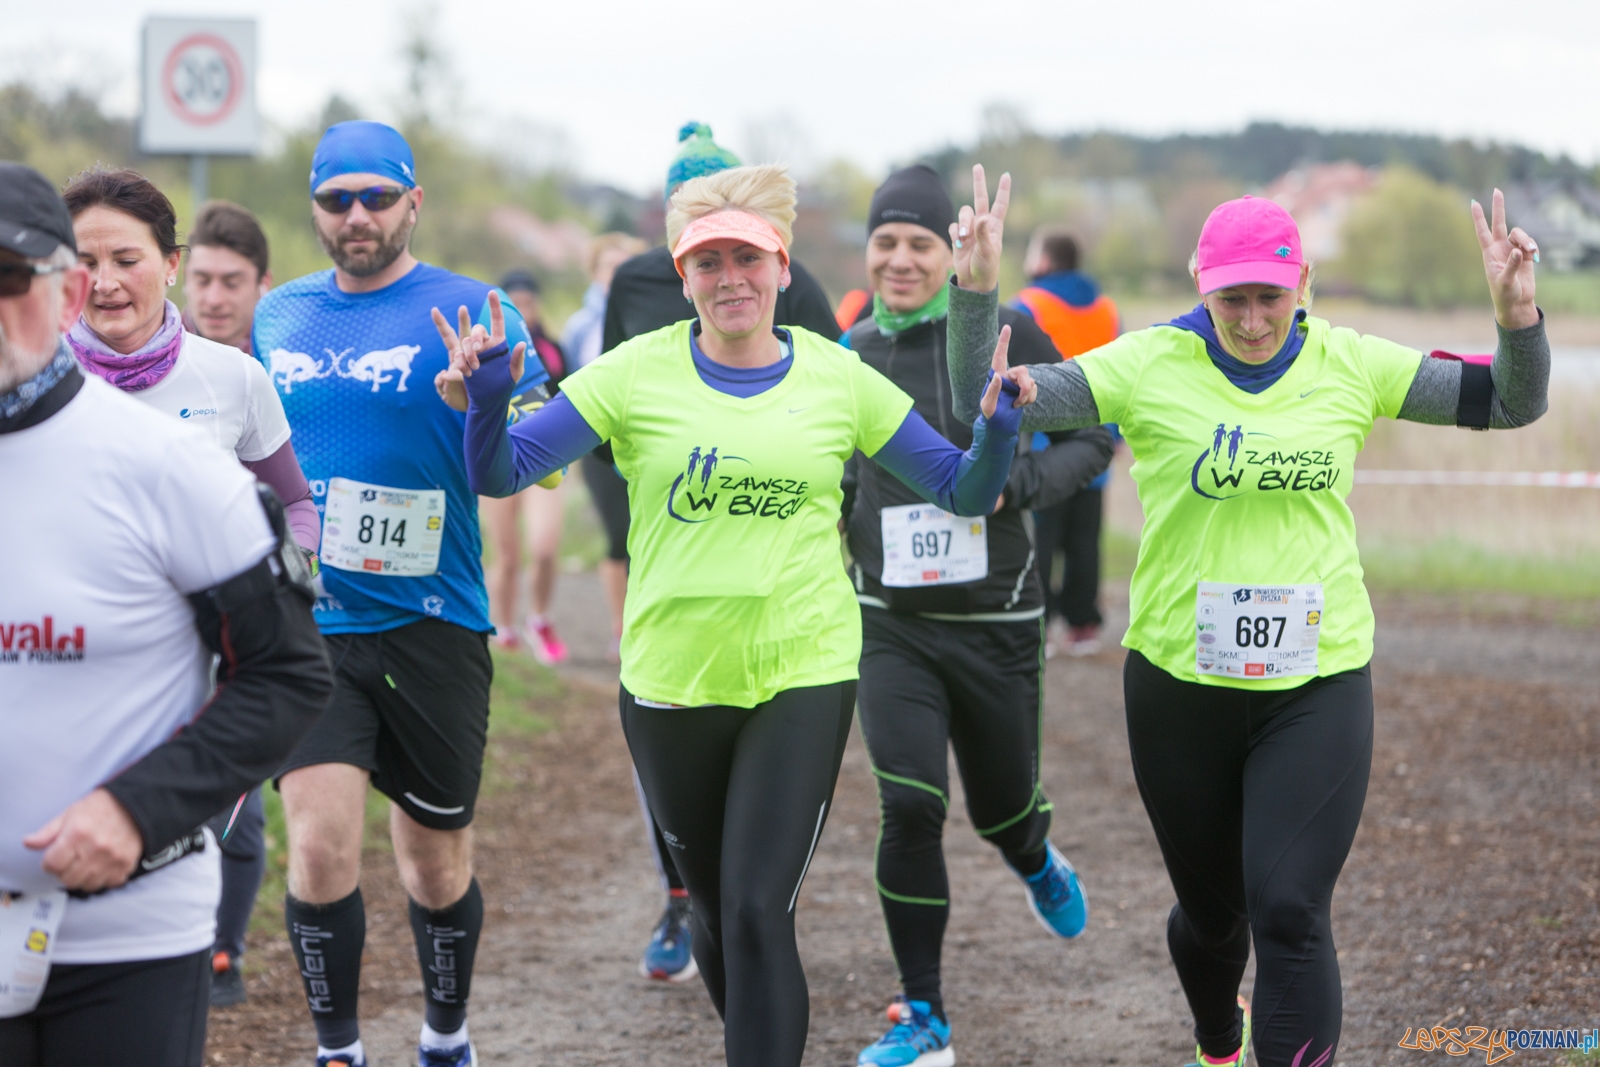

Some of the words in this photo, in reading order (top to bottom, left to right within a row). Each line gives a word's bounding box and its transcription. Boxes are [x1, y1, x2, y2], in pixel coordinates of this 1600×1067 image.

[192, 407, 217, 417] pepsi
[1245, 450, 1335, 467] ZAWSZE
[719, 475, 809, 495] ZAWSZE
[1210, 467, 1244, 489] W
[1257, 468, 1340, 491] BIEGU
[686, 491, 718, 512] W
[728, 495, 808, 520] BIEGU
[358, 514, 407, 548] 814
[912, 530, 952, 559] 697
[1254, 587, 1295, 596] UNIWERSYTECKA
[1235, 615, 1287, 649] 687
[1218, 650, 1238, 660] 5KM
[1279, 650, 1300, 660] 10KM
[293, 922, 334, 1013] kalenji
[426, 923, 467, 1004] kalenji
